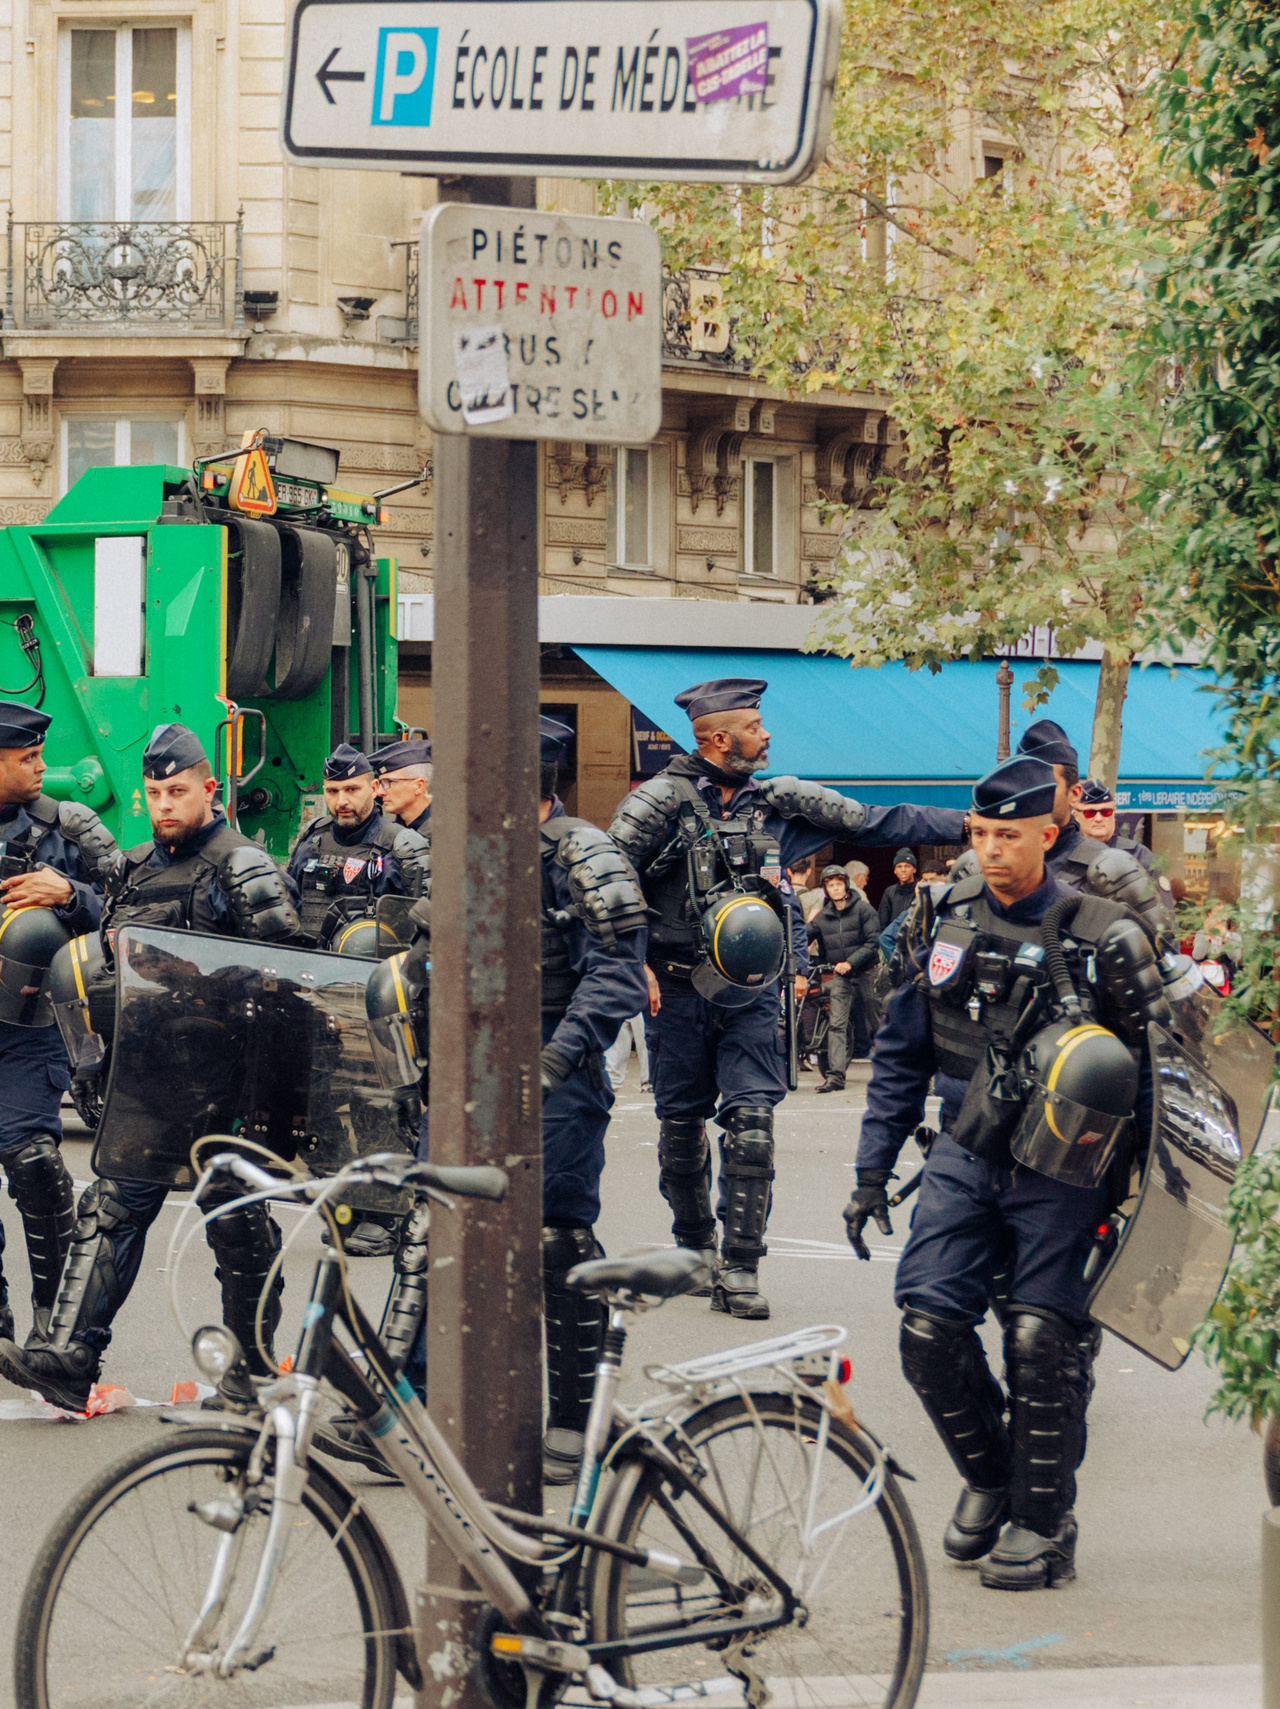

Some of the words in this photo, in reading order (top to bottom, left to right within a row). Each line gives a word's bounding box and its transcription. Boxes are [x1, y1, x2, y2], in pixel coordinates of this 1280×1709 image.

[451, 29, 549, 110] ÉCOLE
[559, 45, 601, 111] DE
[611, 28, 783, 113] MÉDEE
[473, 225, 622, 270] PIÉTONS
[451, 277, 644, 322] ATTENTION
[447, 379, 561, 418] CTRE
[933, 955, 956, 969] CRS
